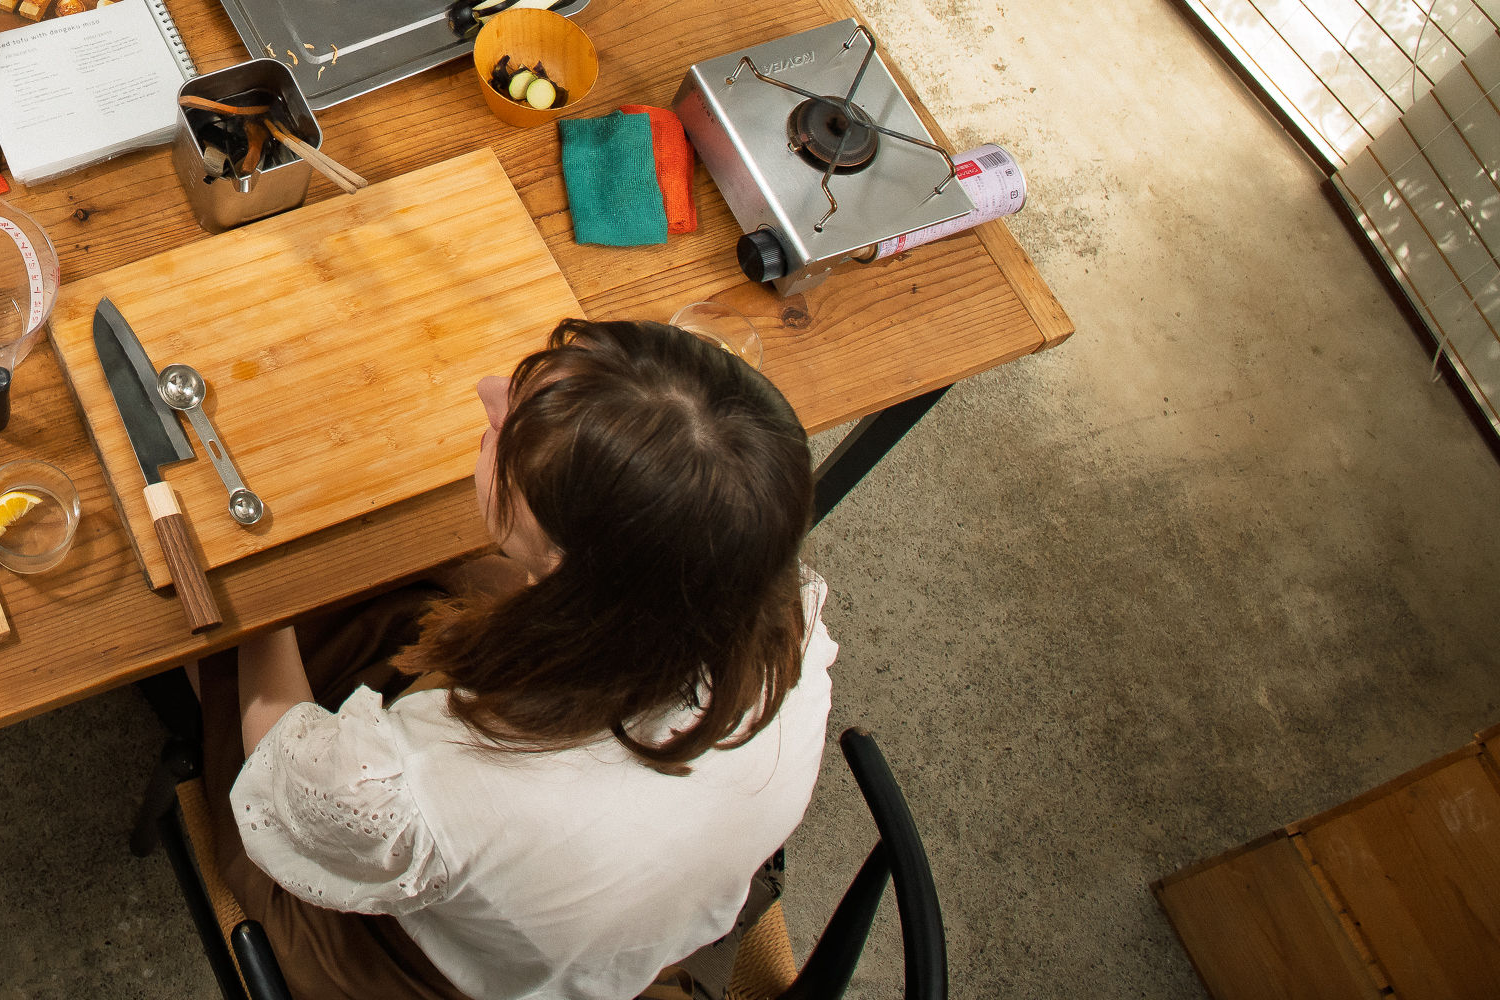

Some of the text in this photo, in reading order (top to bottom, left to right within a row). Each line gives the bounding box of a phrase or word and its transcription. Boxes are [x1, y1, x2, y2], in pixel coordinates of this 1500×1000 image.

[13, 36, 29, 46] tofu
[31, 32, 48, 40] with
[82, 19, 100, 28] miso
